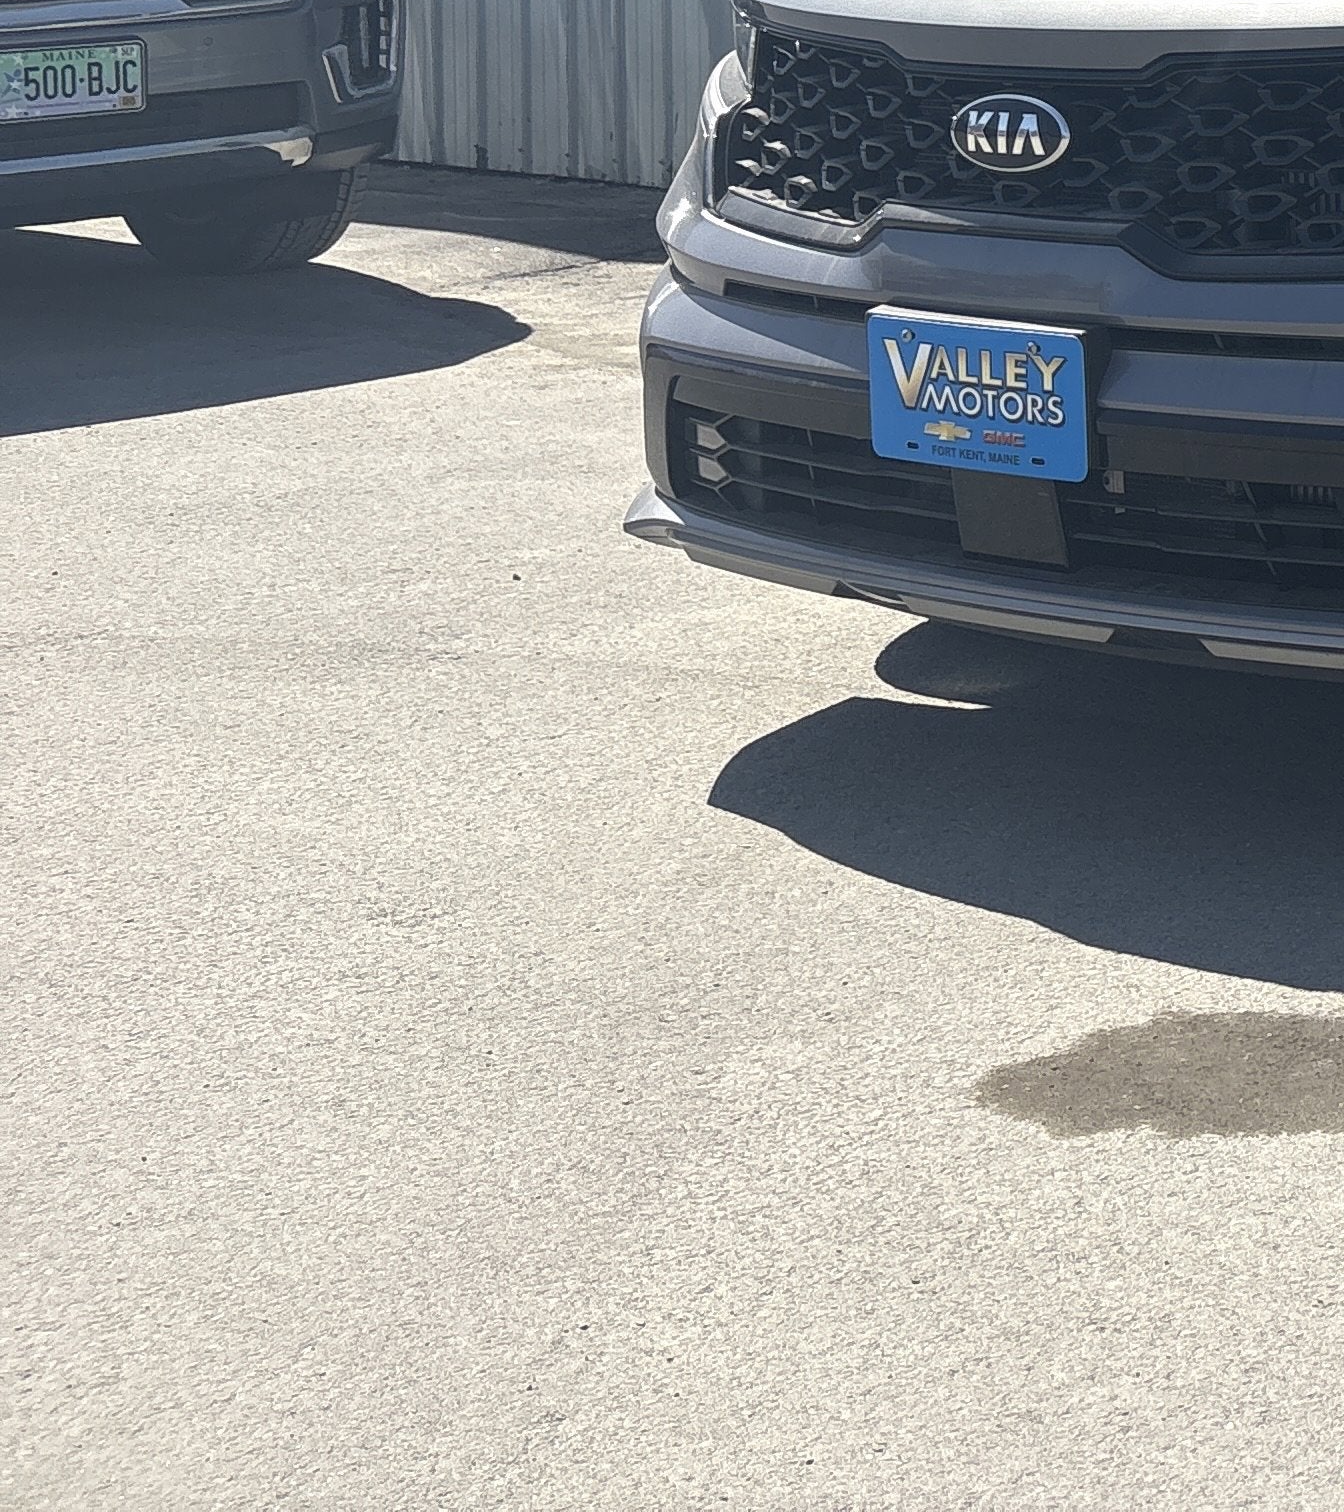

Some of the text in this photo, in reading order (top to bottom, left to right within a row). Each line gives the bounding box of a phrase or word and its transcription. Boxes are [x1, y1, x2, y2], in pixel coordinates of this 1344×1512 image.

[41, 49, 97, 63] MAINE
[967, 110, 1046, 156] KIA
[883, 338, 1066, 408] VALLEY
[921, 383, 1066, 428] MOTORS
[931, 445, 956, 458] FORT
[988, 451, 1021, 466] MAINE
